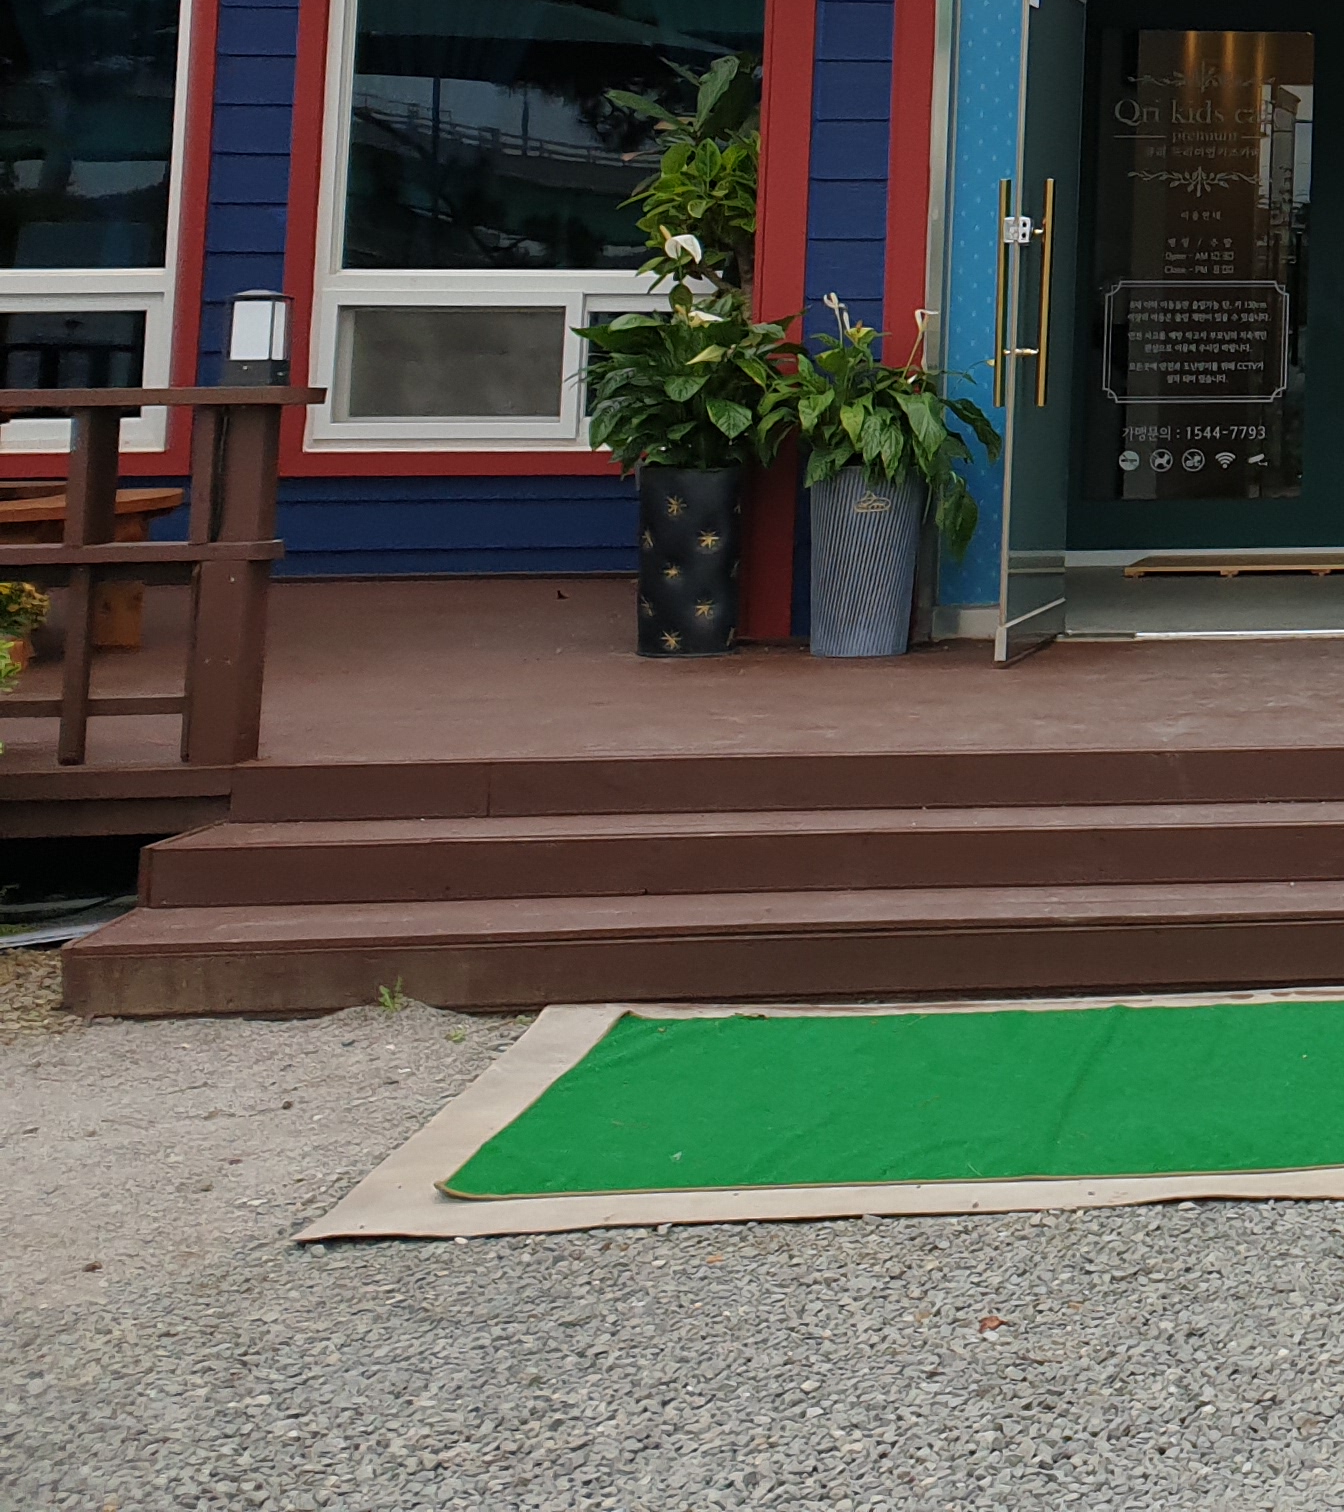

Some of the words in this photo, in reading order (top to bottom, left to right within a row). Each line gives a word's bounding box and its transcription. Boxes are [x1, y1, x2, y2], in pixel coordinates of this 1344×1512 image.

[1171, 99, 1225, 124] kids
[1172, 129, 1237, 143] premium
[1122, 425, 1172, 442] 가맹문의
[1186, 426, 1266, 440] 1544-7793
